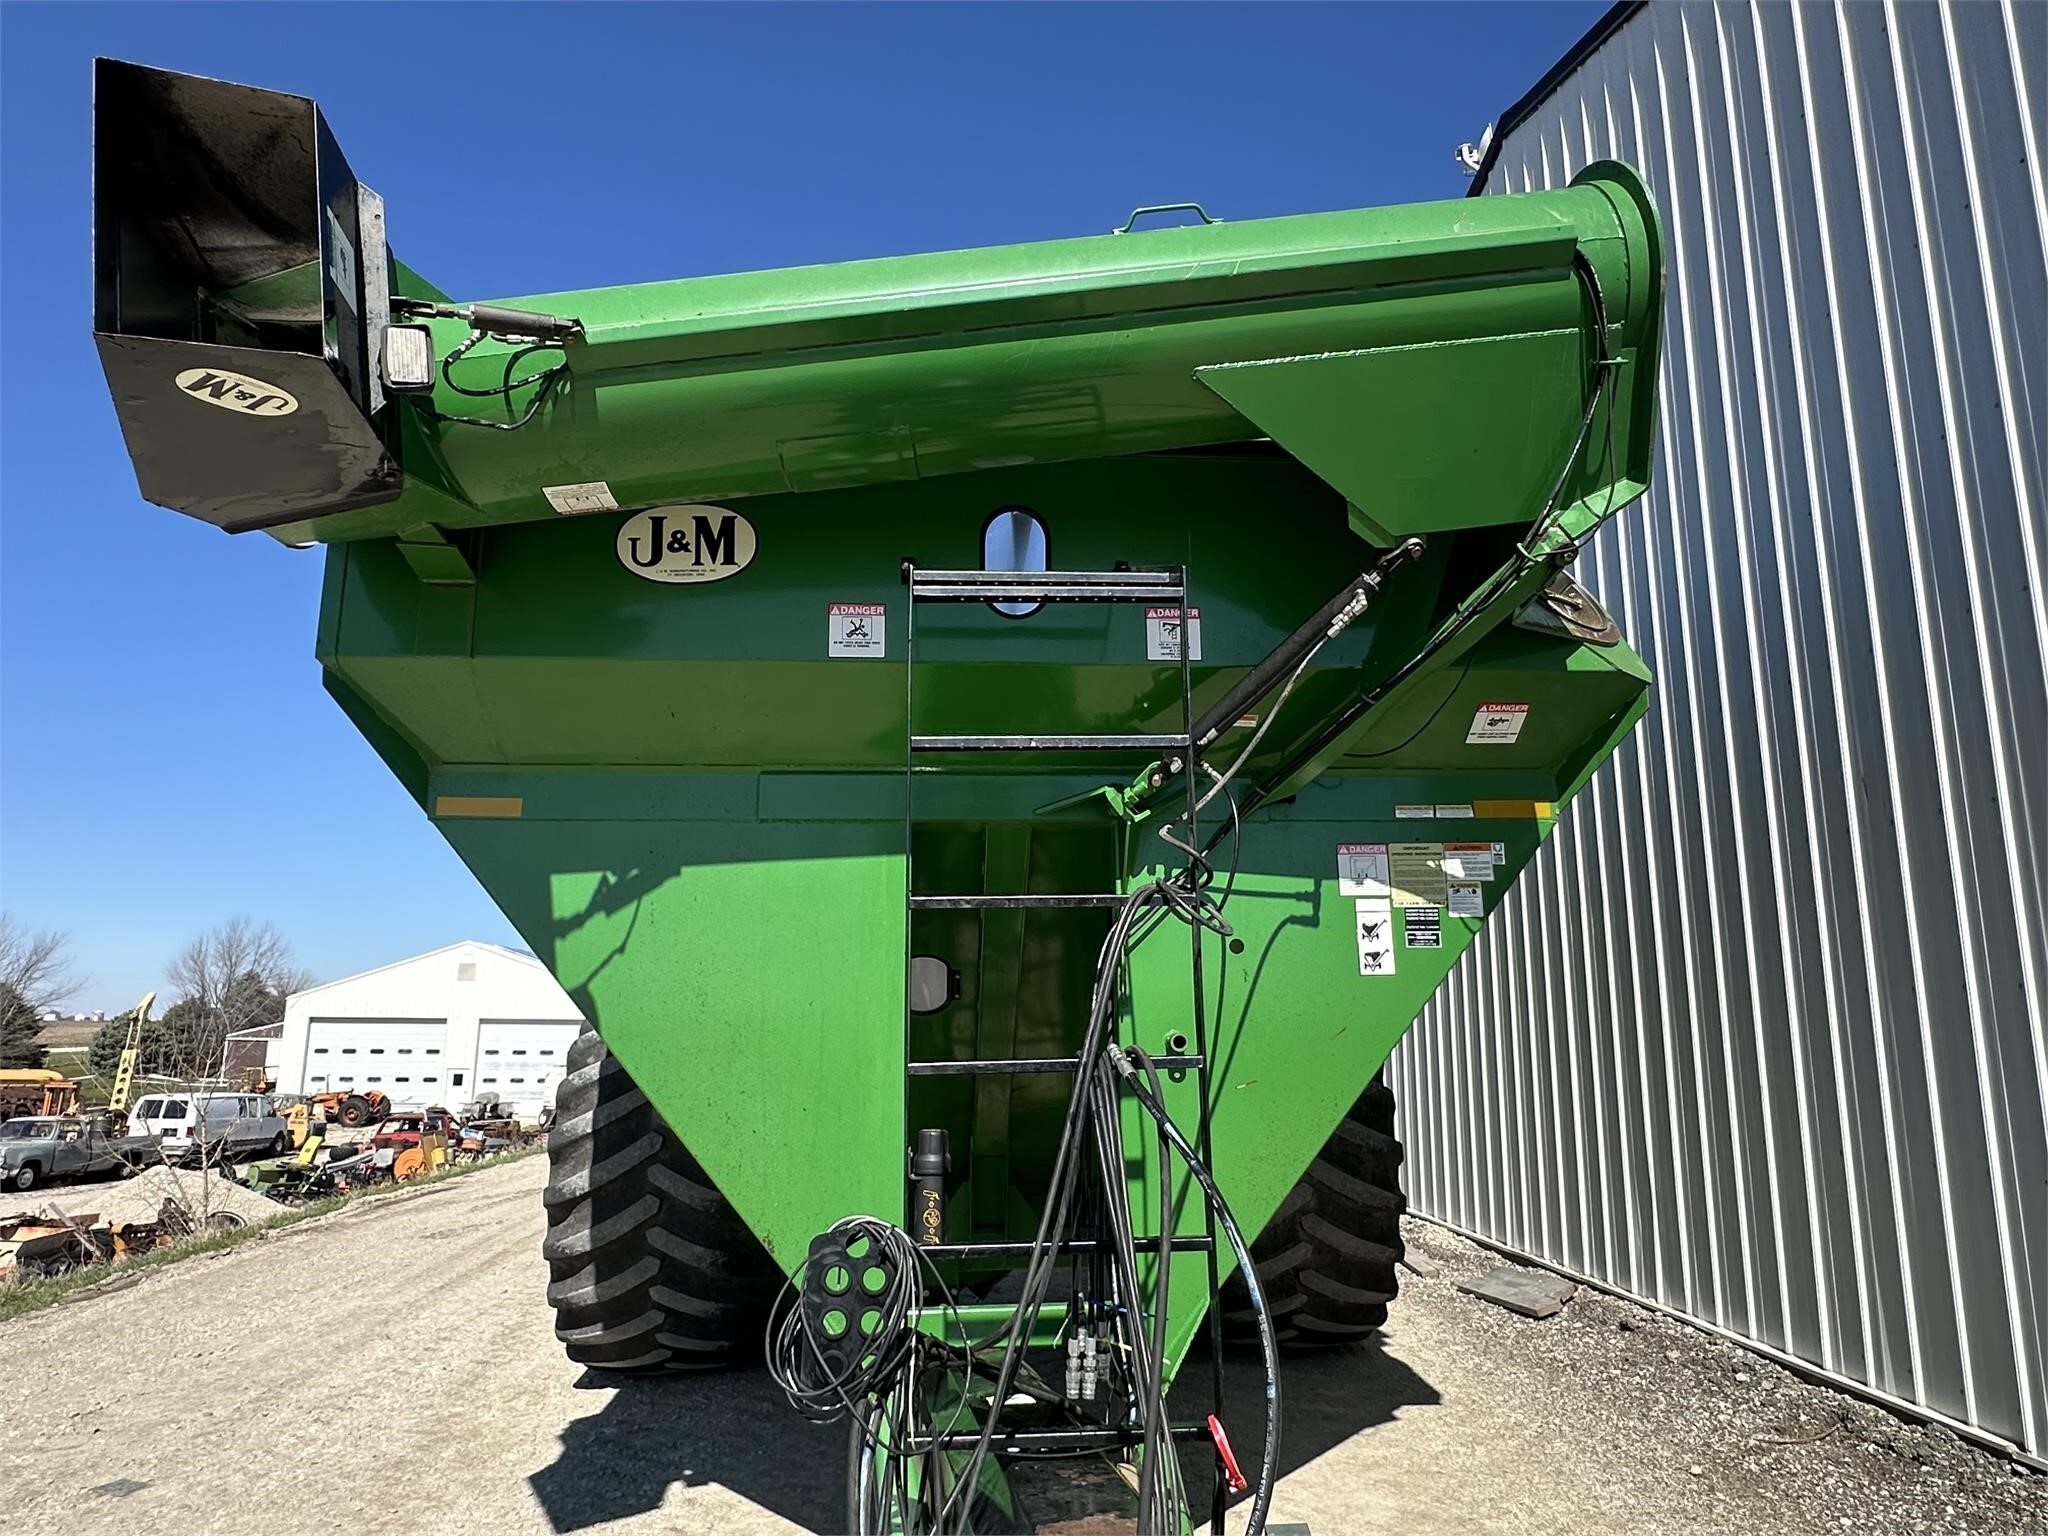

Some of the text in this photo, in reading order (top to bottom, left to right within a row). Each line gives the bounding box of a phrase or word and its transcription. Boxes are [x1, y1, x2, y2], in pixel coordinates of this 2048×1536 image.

[182, 370, 290, 412] J&M
[627, 515, 739, 568] J&M
[840, 606, 884, 615] DANGER
[1157, 608, 1200, 618] DANER
[1488, 704, 1529, 712] DANGER
[1349, 845, 1387, 854] DANGER
